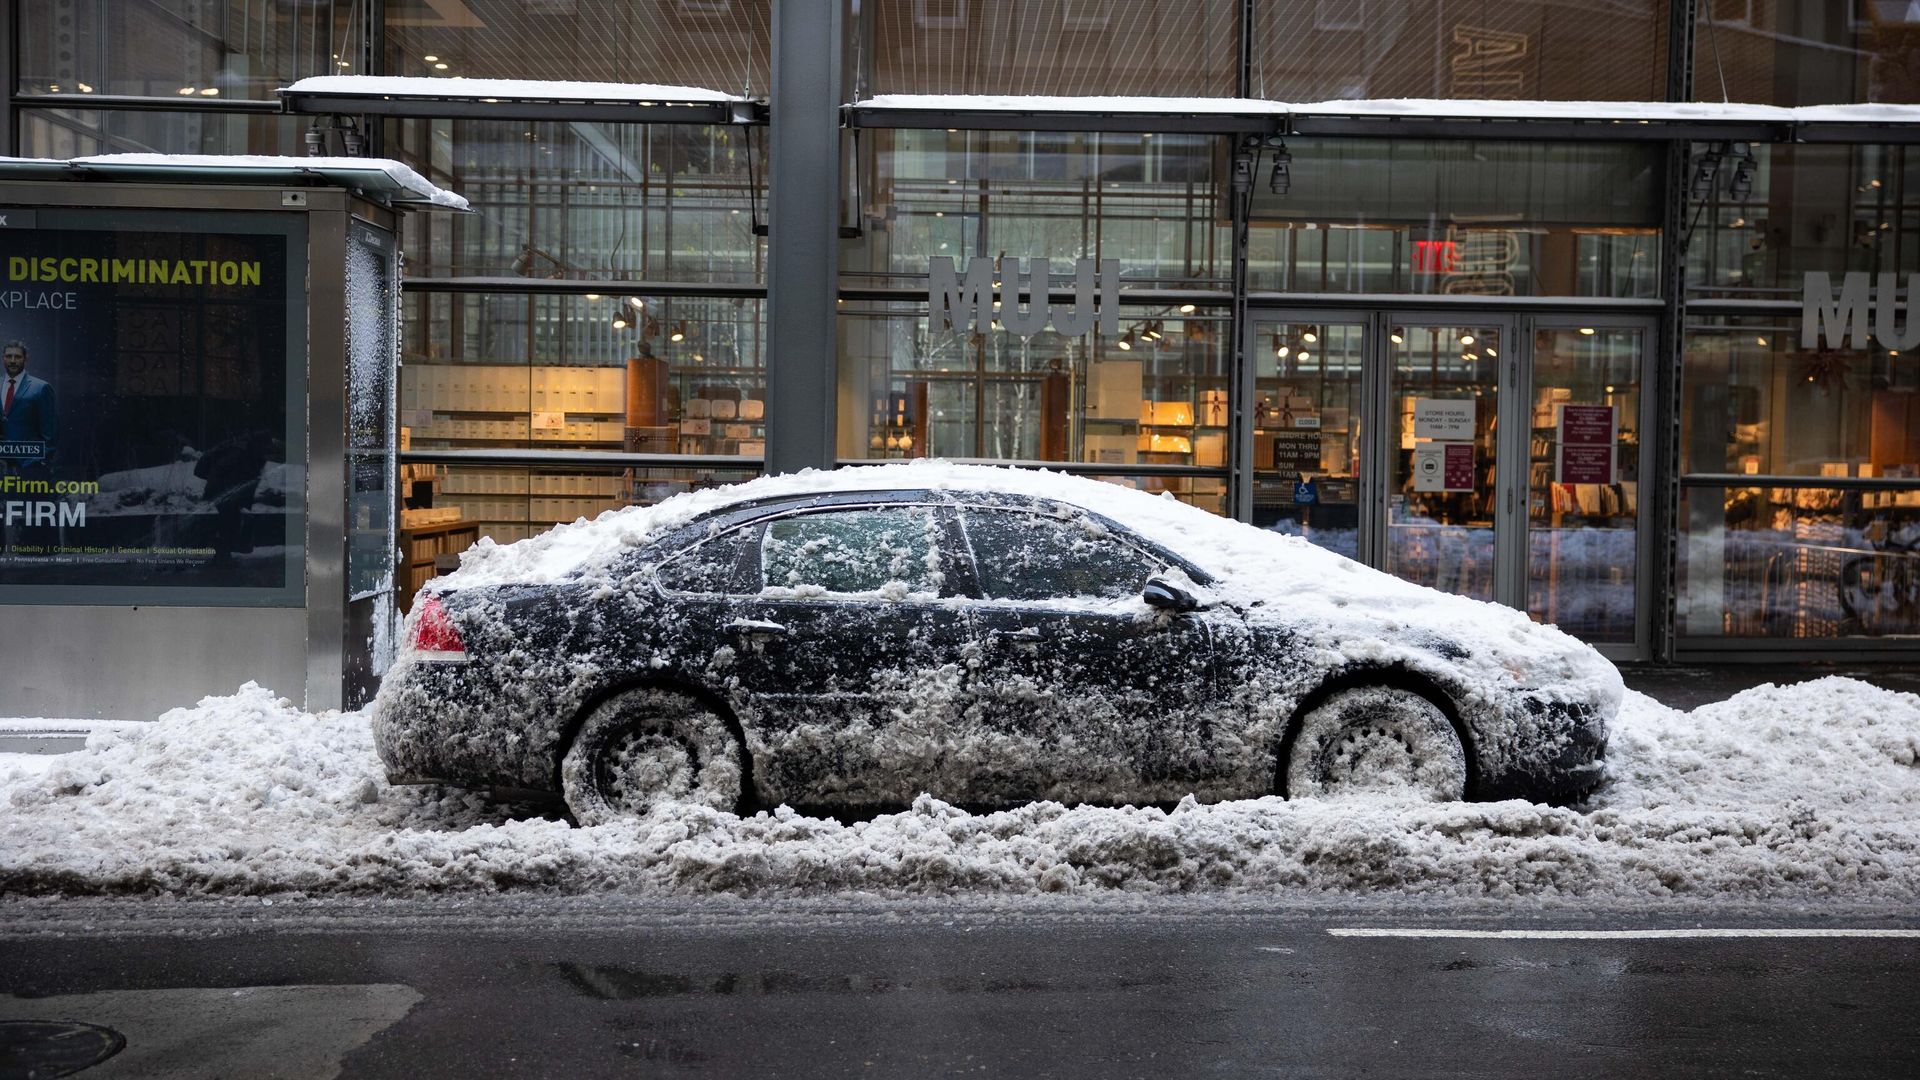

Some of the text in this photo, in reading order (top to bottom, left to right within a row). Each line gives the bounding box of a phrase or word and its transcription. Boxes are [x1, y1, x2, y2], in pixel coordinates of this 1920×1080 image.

[9, 256, 261, 286] DISCRIMINATION
[929, 256, 1120, 337] MUJI
[12, 545, 217, 555] Disability Criminal History Gender Sexual Orientation
